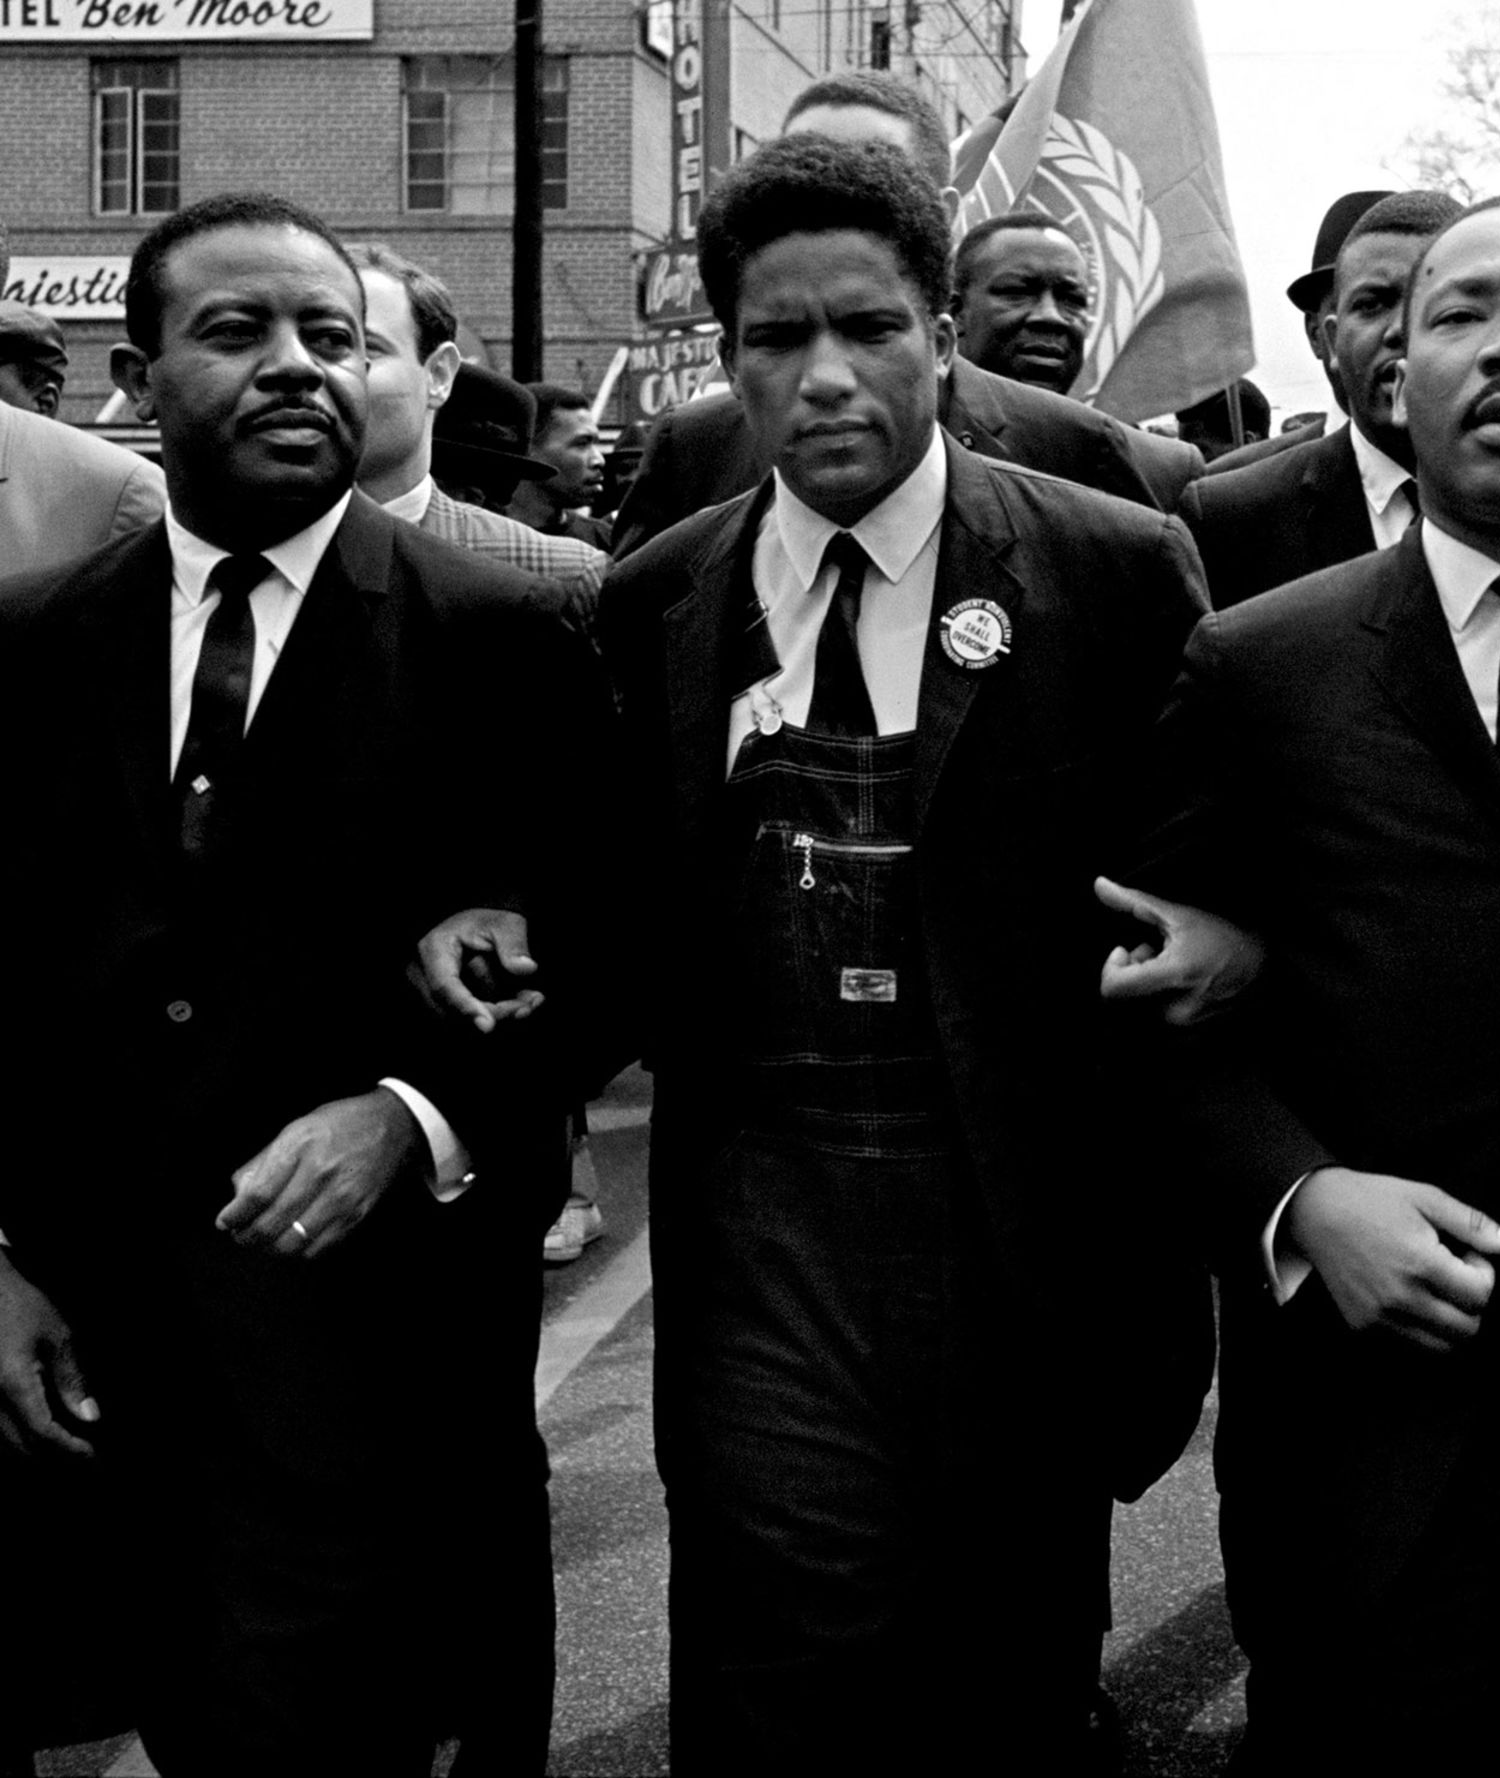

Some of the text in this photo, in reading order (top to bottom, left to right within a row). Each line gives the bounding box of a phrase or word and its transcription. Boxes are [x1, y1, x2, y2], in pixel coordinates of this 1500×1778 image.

[76, 0, 164, 28] Ben
[174, 0, 332, 28] Moore
[674, 0, 702, 241] HOTEL
[964, 622, 990, 641] SHALL
[978, 615, 990, 627] WE
[952, 631, 990, 655] OVERCOME
